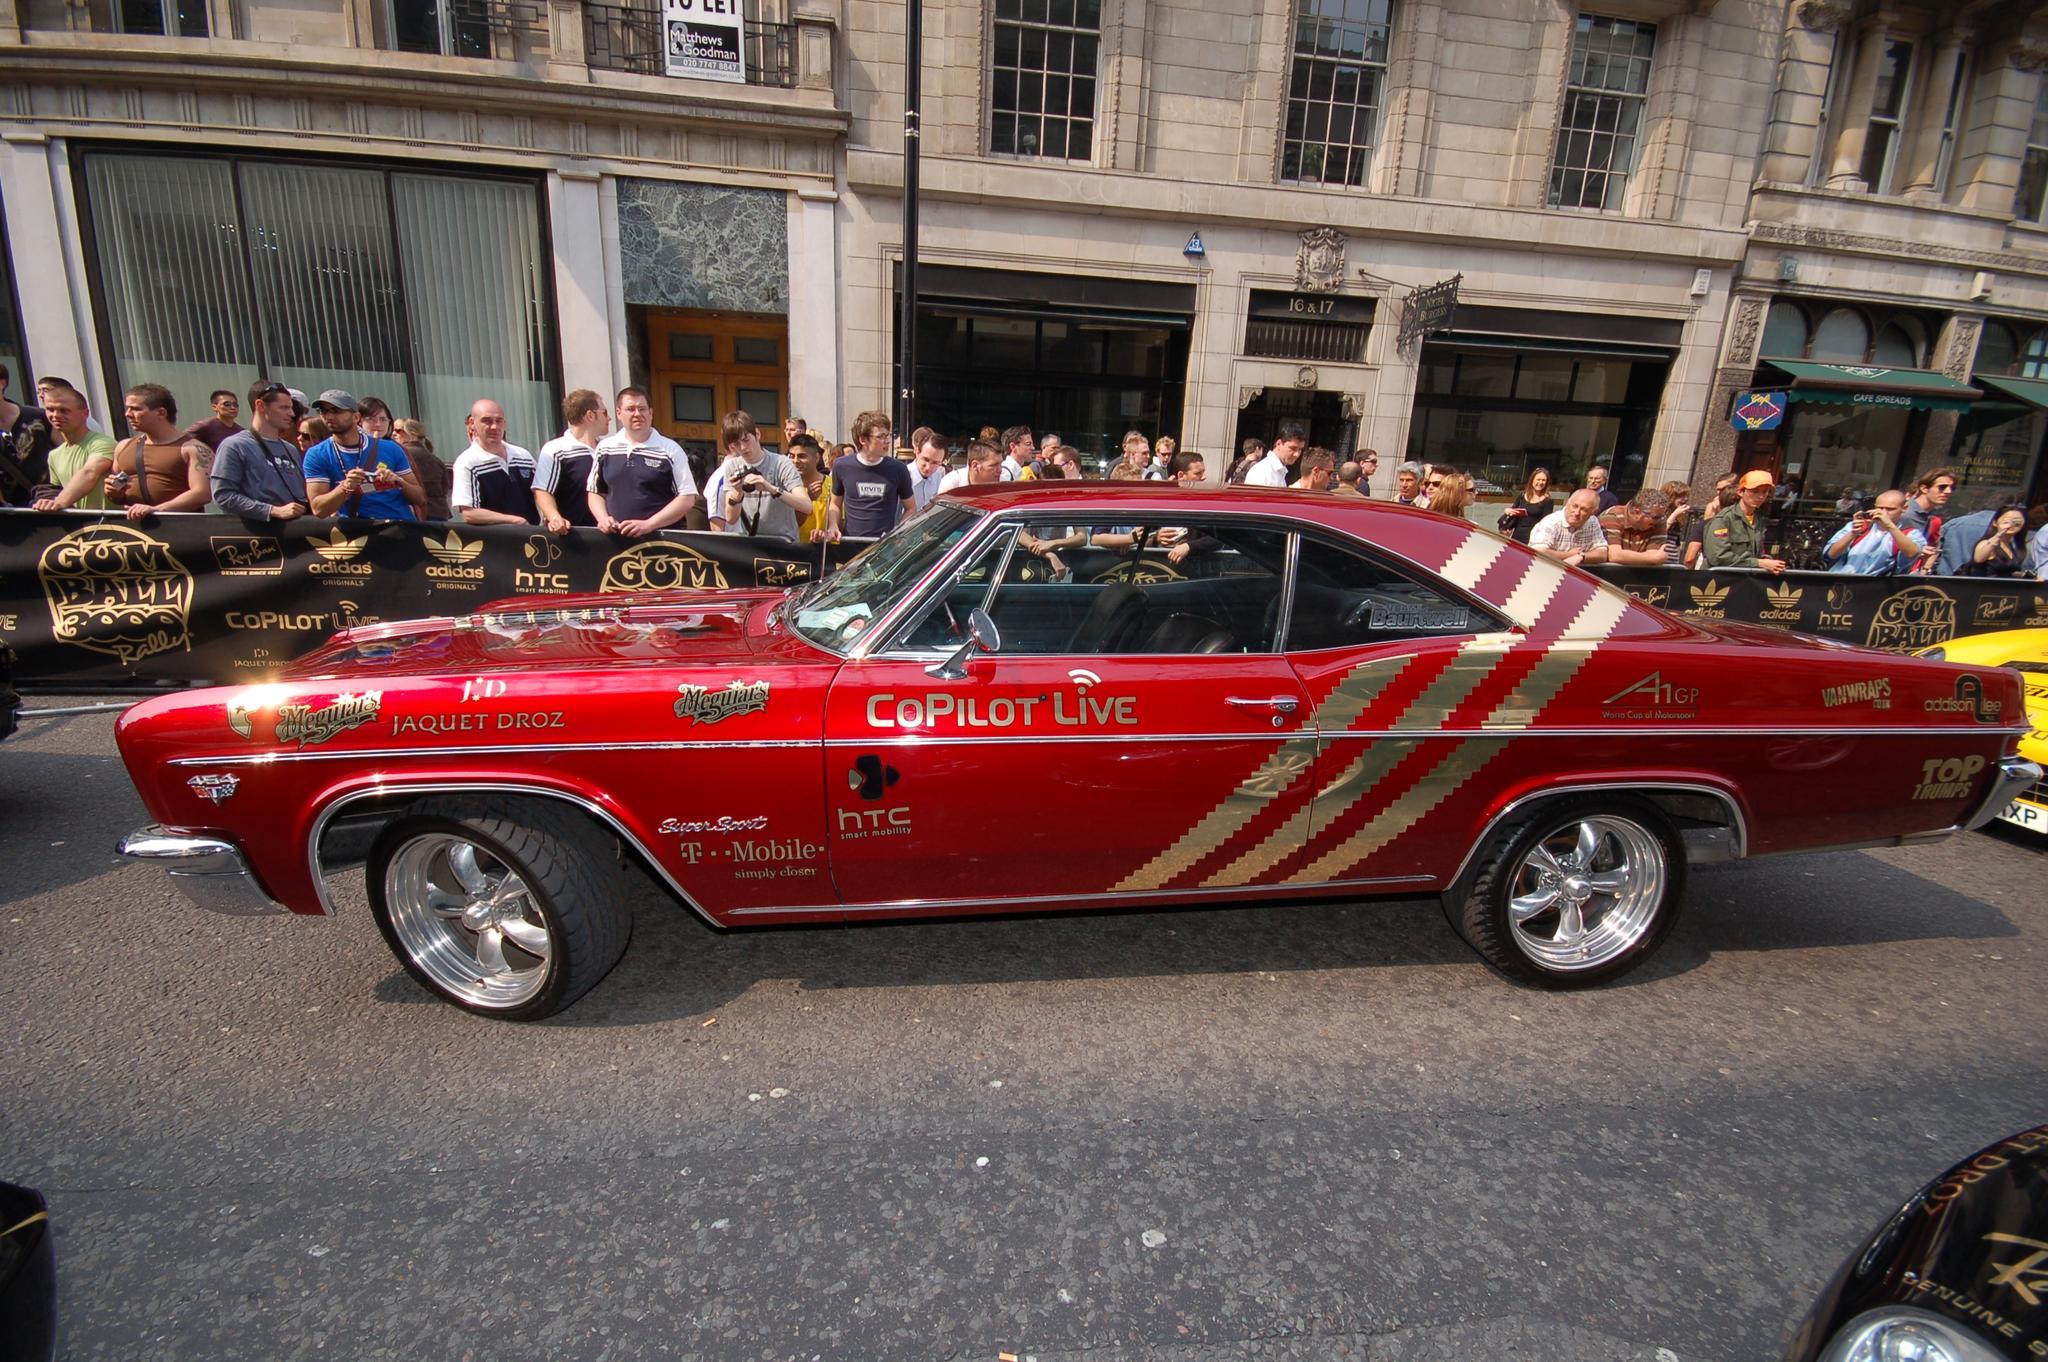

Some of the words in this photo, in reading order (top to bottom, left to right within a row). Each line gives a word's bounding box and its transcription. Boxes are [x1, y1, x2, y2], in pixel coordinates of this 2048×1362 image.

[703, 0, 736, 15] LET
[670, 29, 723, 46] Matthews
[670, 42, 680, 54] &
[683, 43, 737, 61] Goodman
[683, 59, 697, 67] 020
[699, 60, 717, 69] 7747
[1289, 298, 1304, 312] 16
[1307, 303, 1316, 313] &
[1319, 300, 1335, 315] 17
[1875, 395, 1912, 405] SPREADS
[308, 562, 372, 574] adidas
[425, 565, 484, 579] adidas
[436, 582, 477, 590] ORIGINALS
[1760, 608, 1801, 620] adidas
[116, 634, 192, 665] Rally
[1924, 697, 1974, 711] addison
[1627, 711, 1643, 720] Cup
[1655, 711, 1695, 720] Motorsport
[392, 714, 489, 737] JAQUET
[497, 712, 566, 729] DROZ
[1922, 755, 1985, 785] TOP
[1912, 781, 1971, 800] TRUMPS
[840, 829, 867, 840] smart
[871, 826, 912, 838] mobility
[735, 868, 776, 880] simply
[779, 866, 817, 877] closer
[1902, 1271, 2022, 1338] GENUINE
